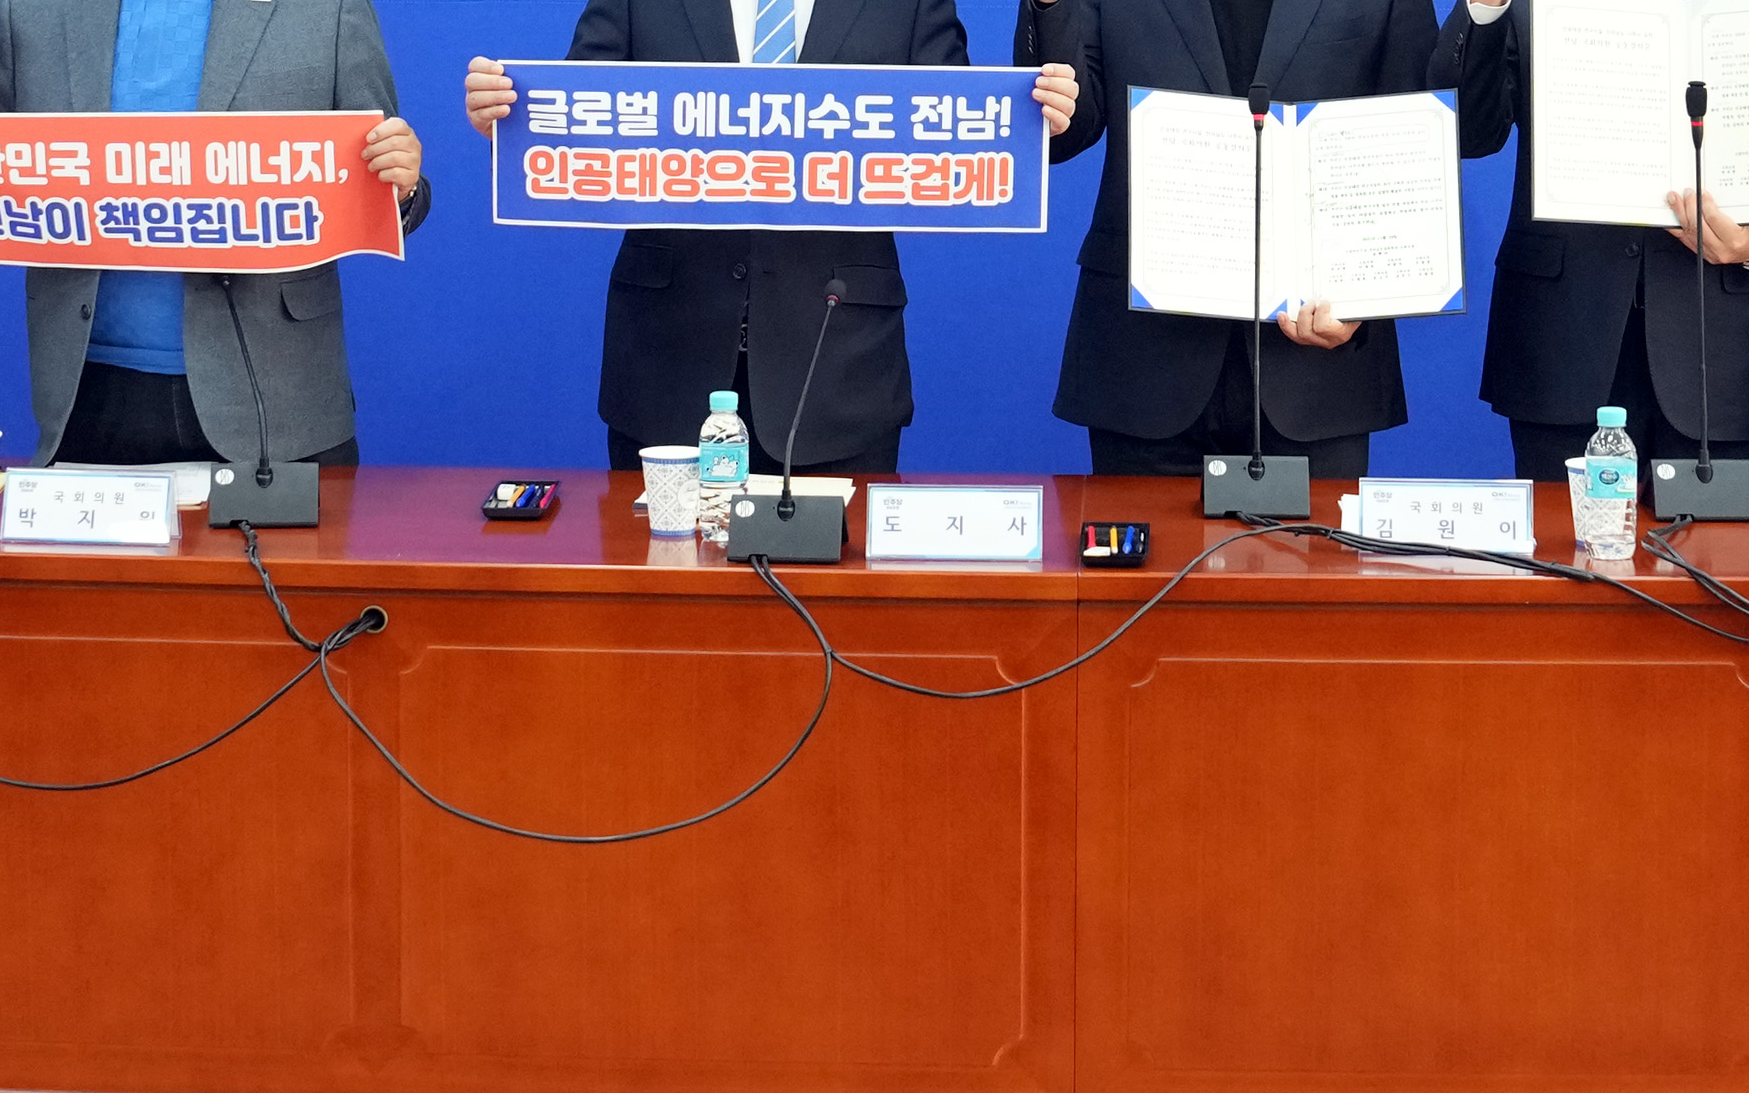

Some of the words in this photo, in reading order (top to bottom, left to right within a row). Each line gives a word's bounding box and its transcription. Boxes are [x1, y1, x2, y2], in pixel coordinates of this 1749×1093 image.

[525, 89, 659, 138] 글로벌
[672, 90, 897, 141] 에너지수도
[909, 94, 1013, 142] 전남!
[105, 139, 191, 186] 미래
[204, 139, 351, 186] 에너지,
[523, 146, 796, 204] 인공태양으로
[801, 151, 853, 206] 더
[859, 151, 1015, 207] 뜨겁게!
[95, 194, 324, 249] 책임집니다
